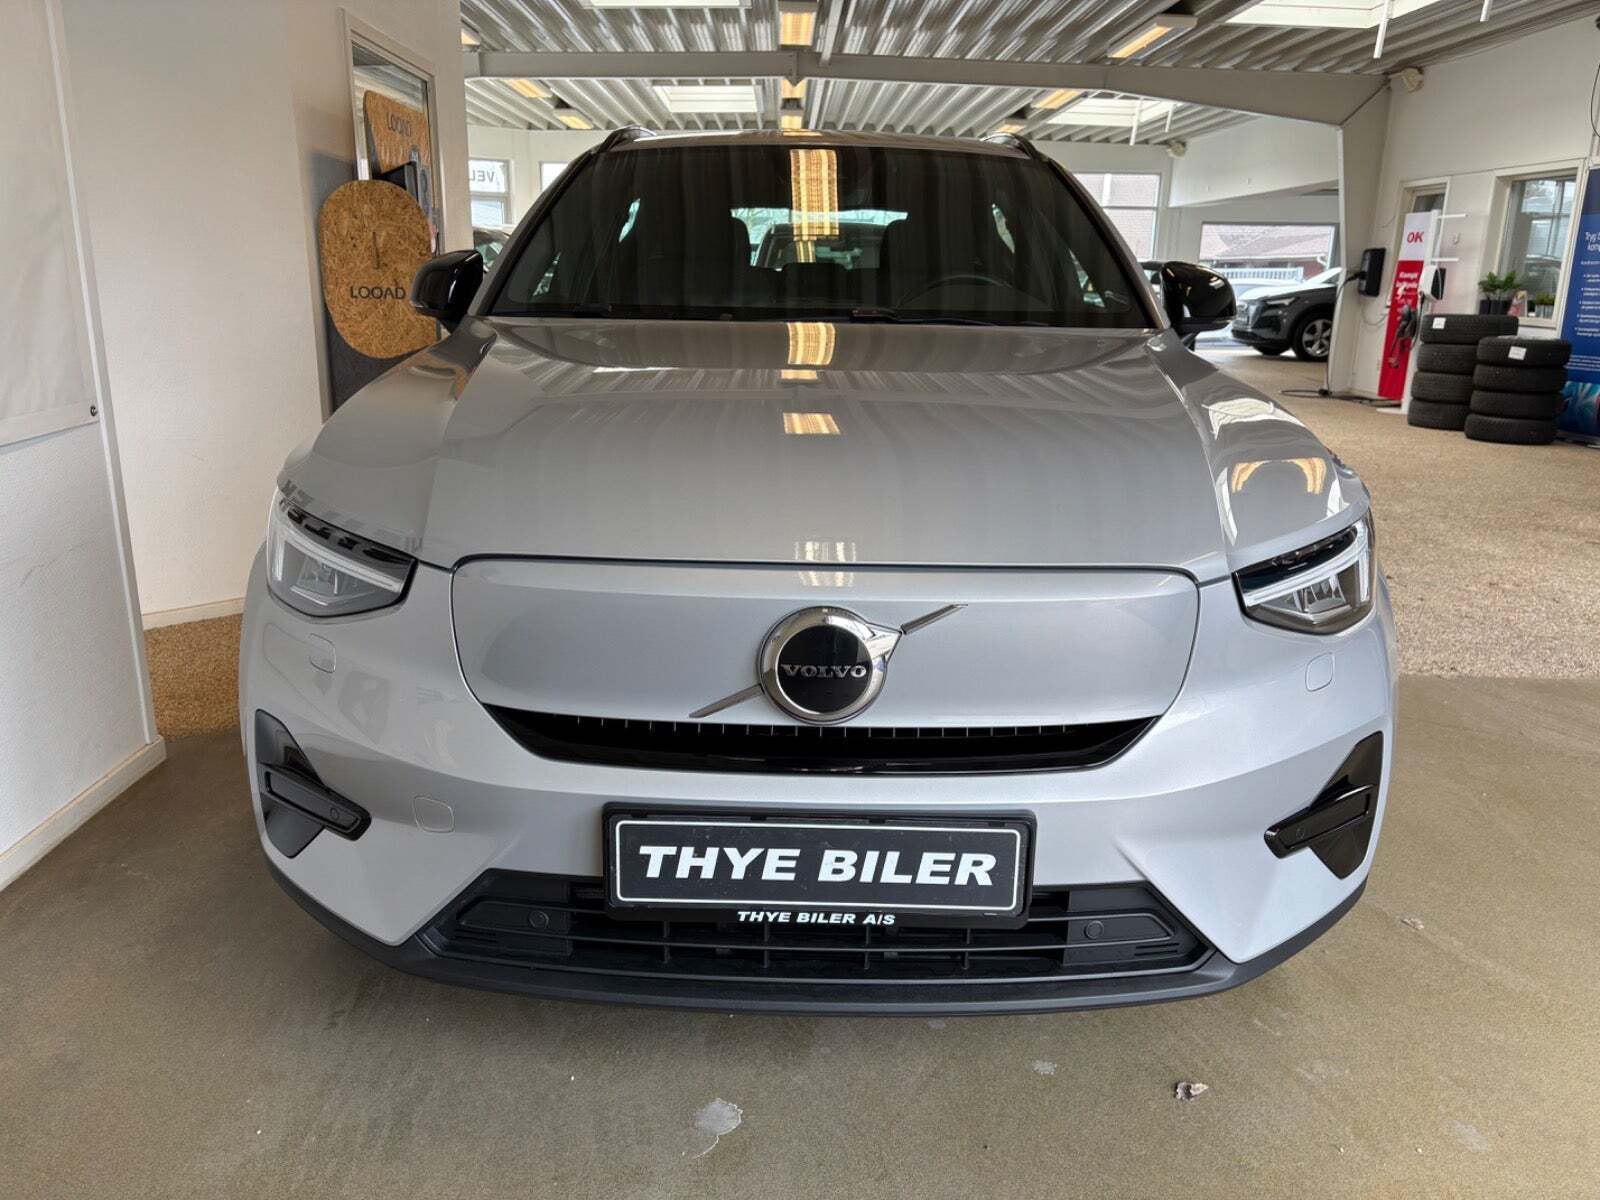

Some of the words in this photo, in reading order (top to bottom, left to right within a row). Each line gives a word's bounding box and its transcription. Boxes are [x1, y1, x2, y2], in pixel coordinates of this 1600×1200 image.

[1406, 231, 1424, 243] OK
[350, 285, 406, 300] LOOAD
[780, 663, 867, 678] VOLVO
[638, 845, 801, 882] THYE
[816, 849, 998, 887] BILER
[737, 911, 792, 923] THYE
[796, 912, 856, 924] BILER
[862, 914, 896, 926] A/S
